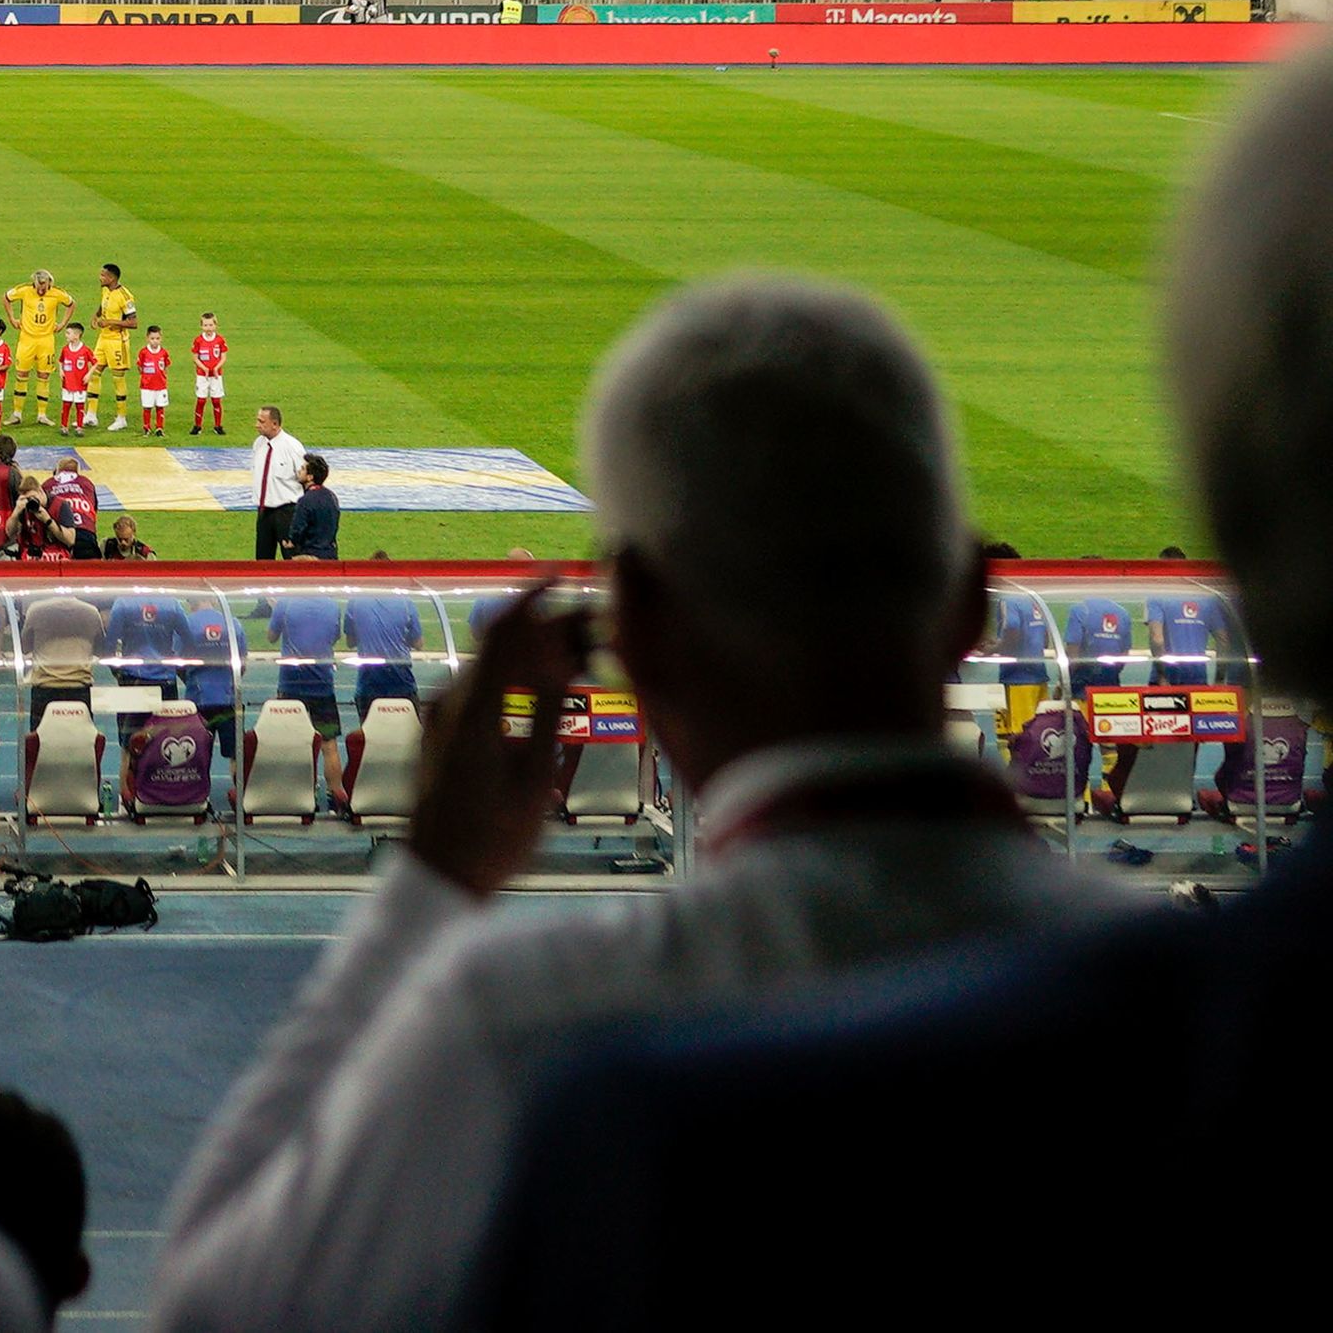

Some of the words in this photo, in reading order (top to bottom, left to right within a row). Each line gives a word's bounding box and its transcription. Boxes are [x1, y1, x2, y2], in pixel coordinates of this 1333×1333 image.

[34, 313, 47, 324] 10
[595, 699, 634, 708] ADMIRAL
[1194, 697, 1234, 706] ADMIRAL
[270, 707, 302, 715] RECARO
[378, 706, 411, 714] RECARO
[1209, 720, 1237, 731] UNIQA
